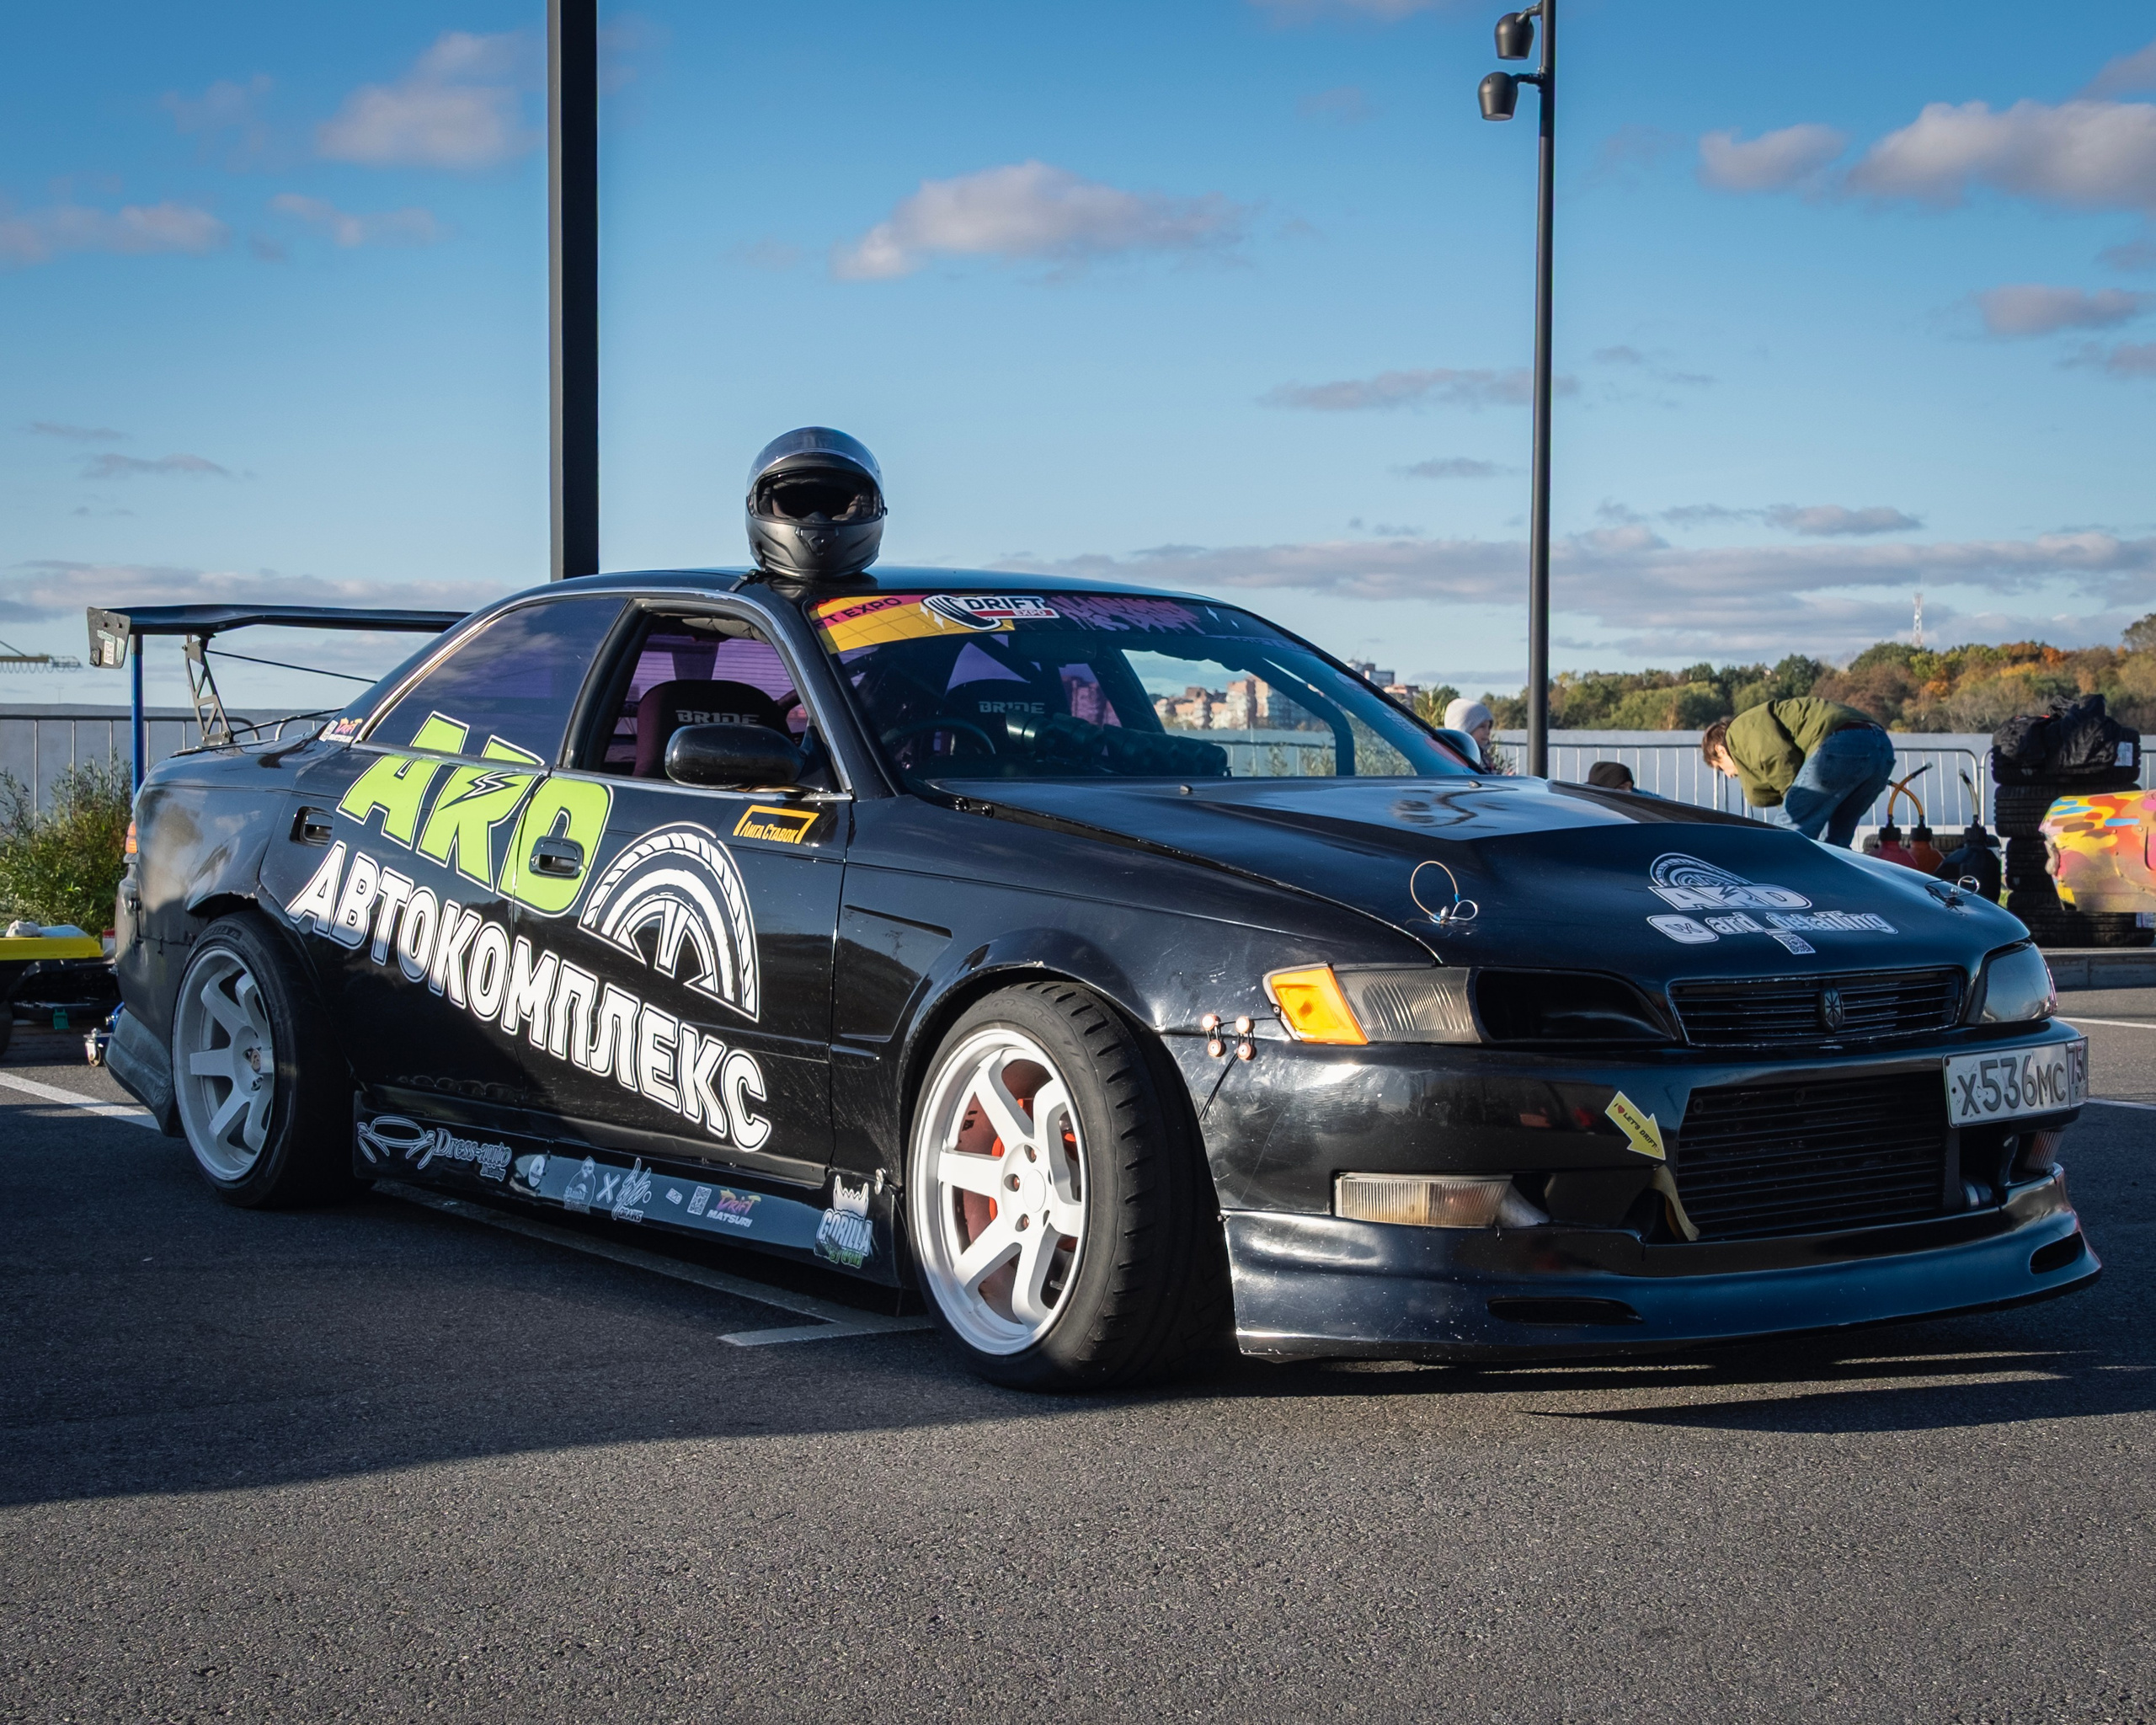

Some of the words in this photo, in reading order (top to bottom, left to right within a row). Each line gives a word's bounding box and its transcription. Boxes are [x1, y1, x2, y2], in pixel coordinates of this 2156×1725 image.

[842, 597, 902, 618] EXPO
[963, 597, 1043, 610] DRIFT
[978, 701, 1045, 713] BRIDE
[285, 841, 771, 1152] АВТОКОМПЛЕКС
[1623, 1112, 1641, 1130] LET'S
[1639, 1130, 1657, 1148] DRIFT
[434, 1128, 512, 1168] Dress-auto
[707, 1209, 753, 1228] MATSURI
[817, 1209, 873, 1257] GORILLA
